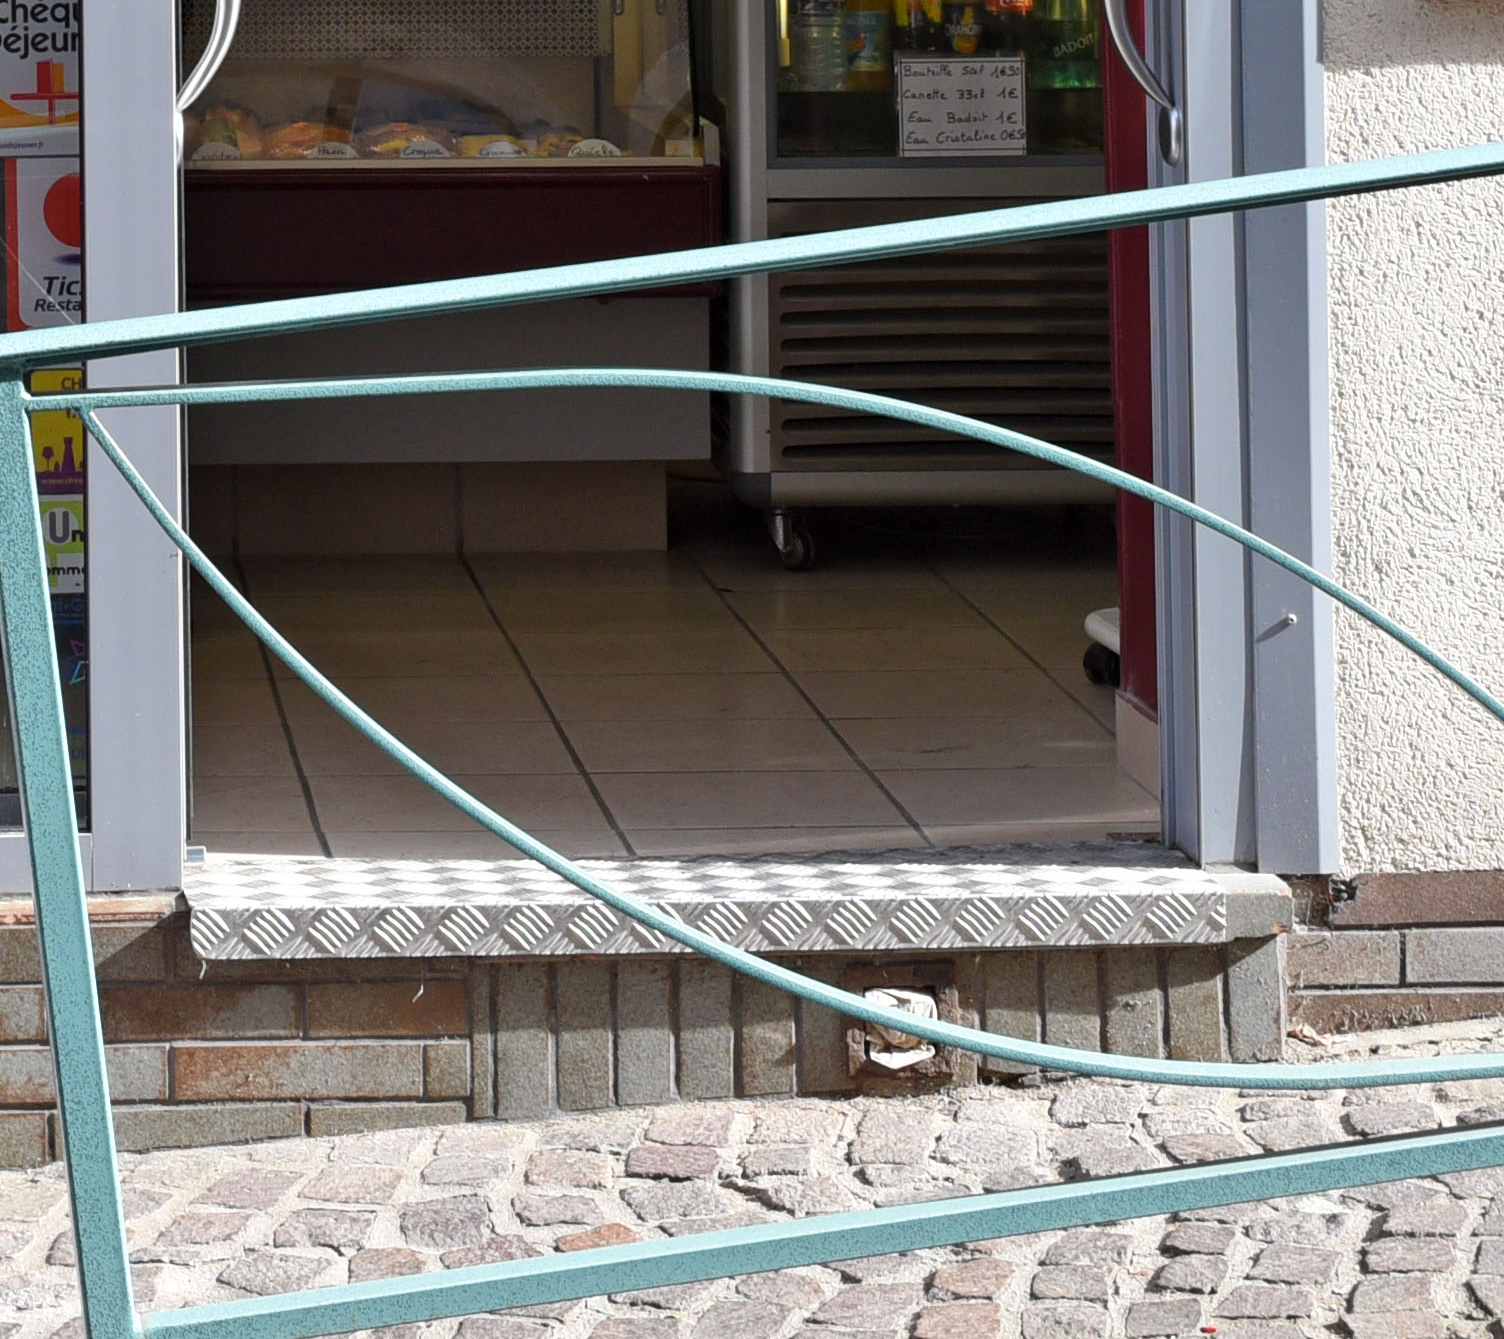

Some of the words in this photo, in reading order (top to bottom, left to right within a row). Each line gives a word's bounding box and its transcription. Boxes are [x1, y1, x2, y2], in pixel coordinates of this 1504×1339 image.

[903, 88, 948, 100] Canette
[907, 111, 933, 123] Eau
[946, 111, 988, 124] Badoit
[905, 131, 928, 144] Eau
[43, 276, 82, 297] Tic
[34, 298, 82, 312] Resta
